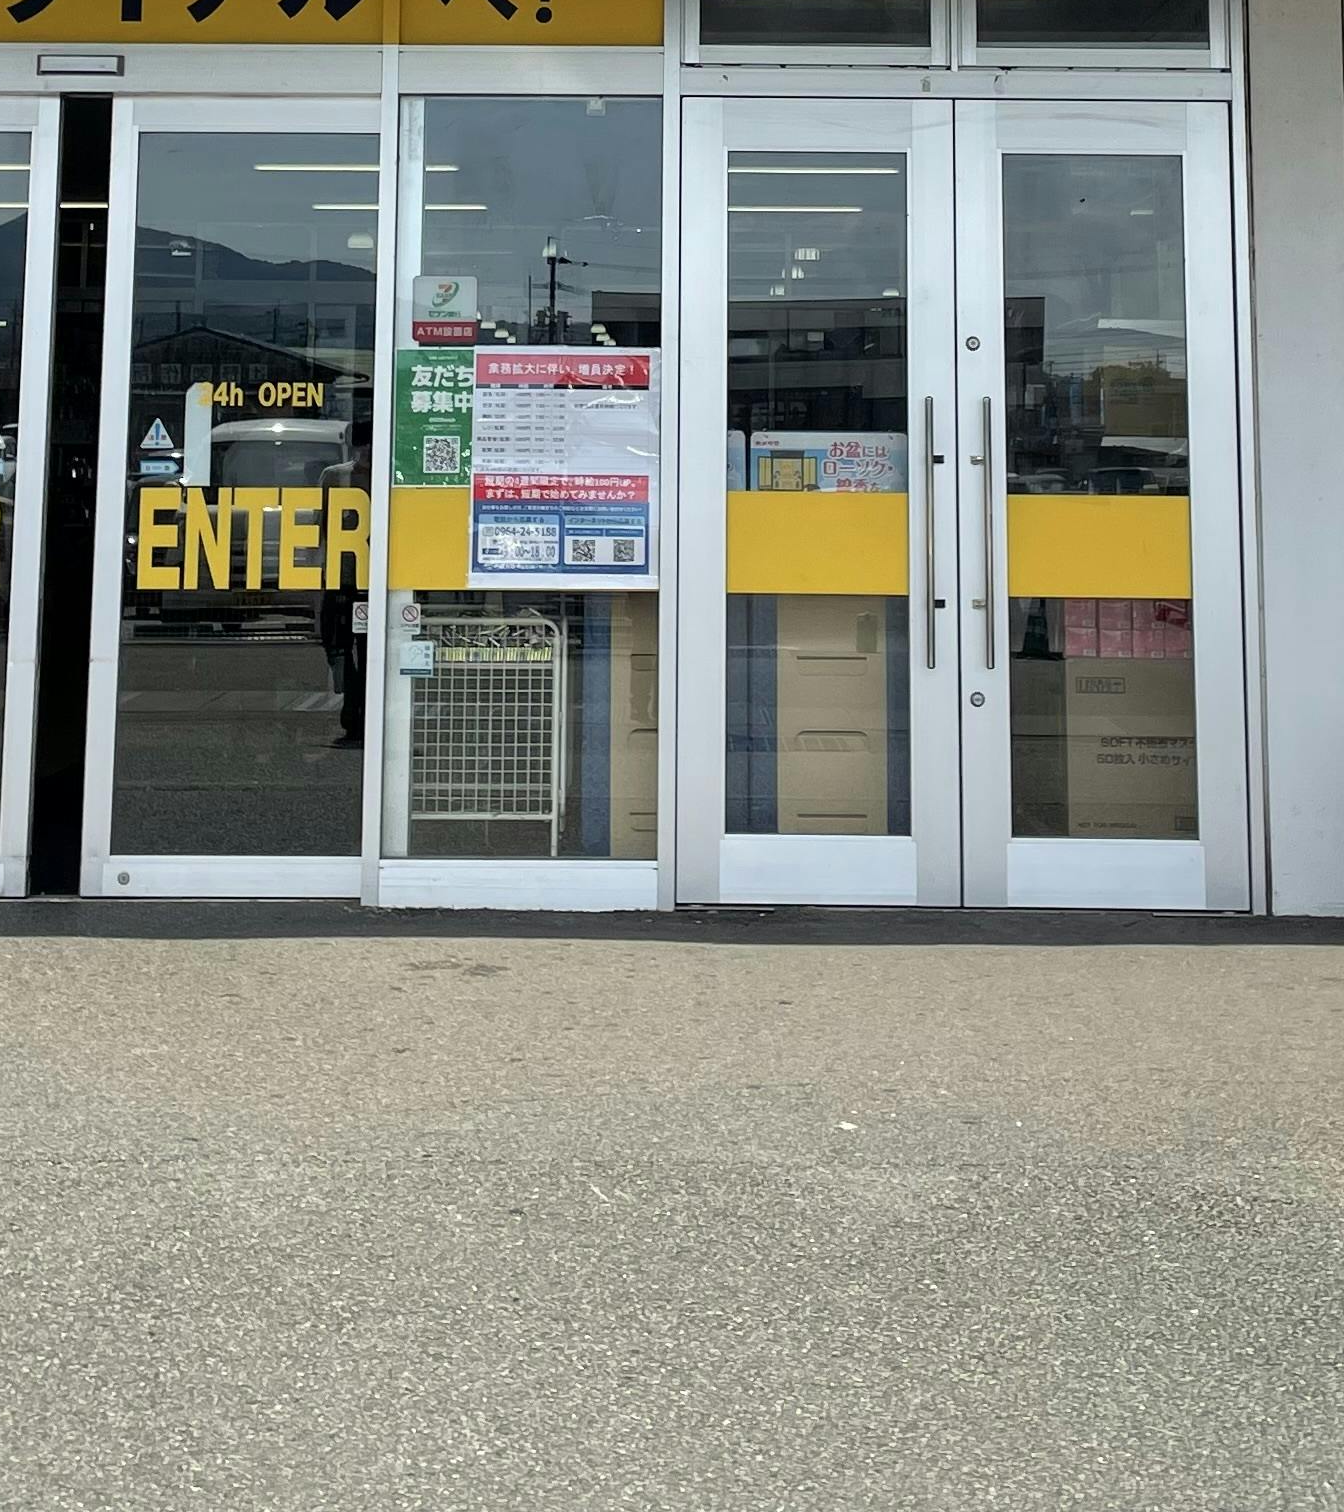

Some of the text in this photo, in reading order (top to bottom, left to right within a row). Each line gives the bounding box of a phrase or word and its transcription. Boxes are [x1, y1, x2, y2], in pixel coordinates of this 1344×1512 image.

[411, 364, 474, 388] 友だち
[258, 382, 324, 407] OPEN
[411, 390, 474, 414] 募集中
[828, 441, 889, 459] お盆には
[136, 487, 371, 590] ENTER
